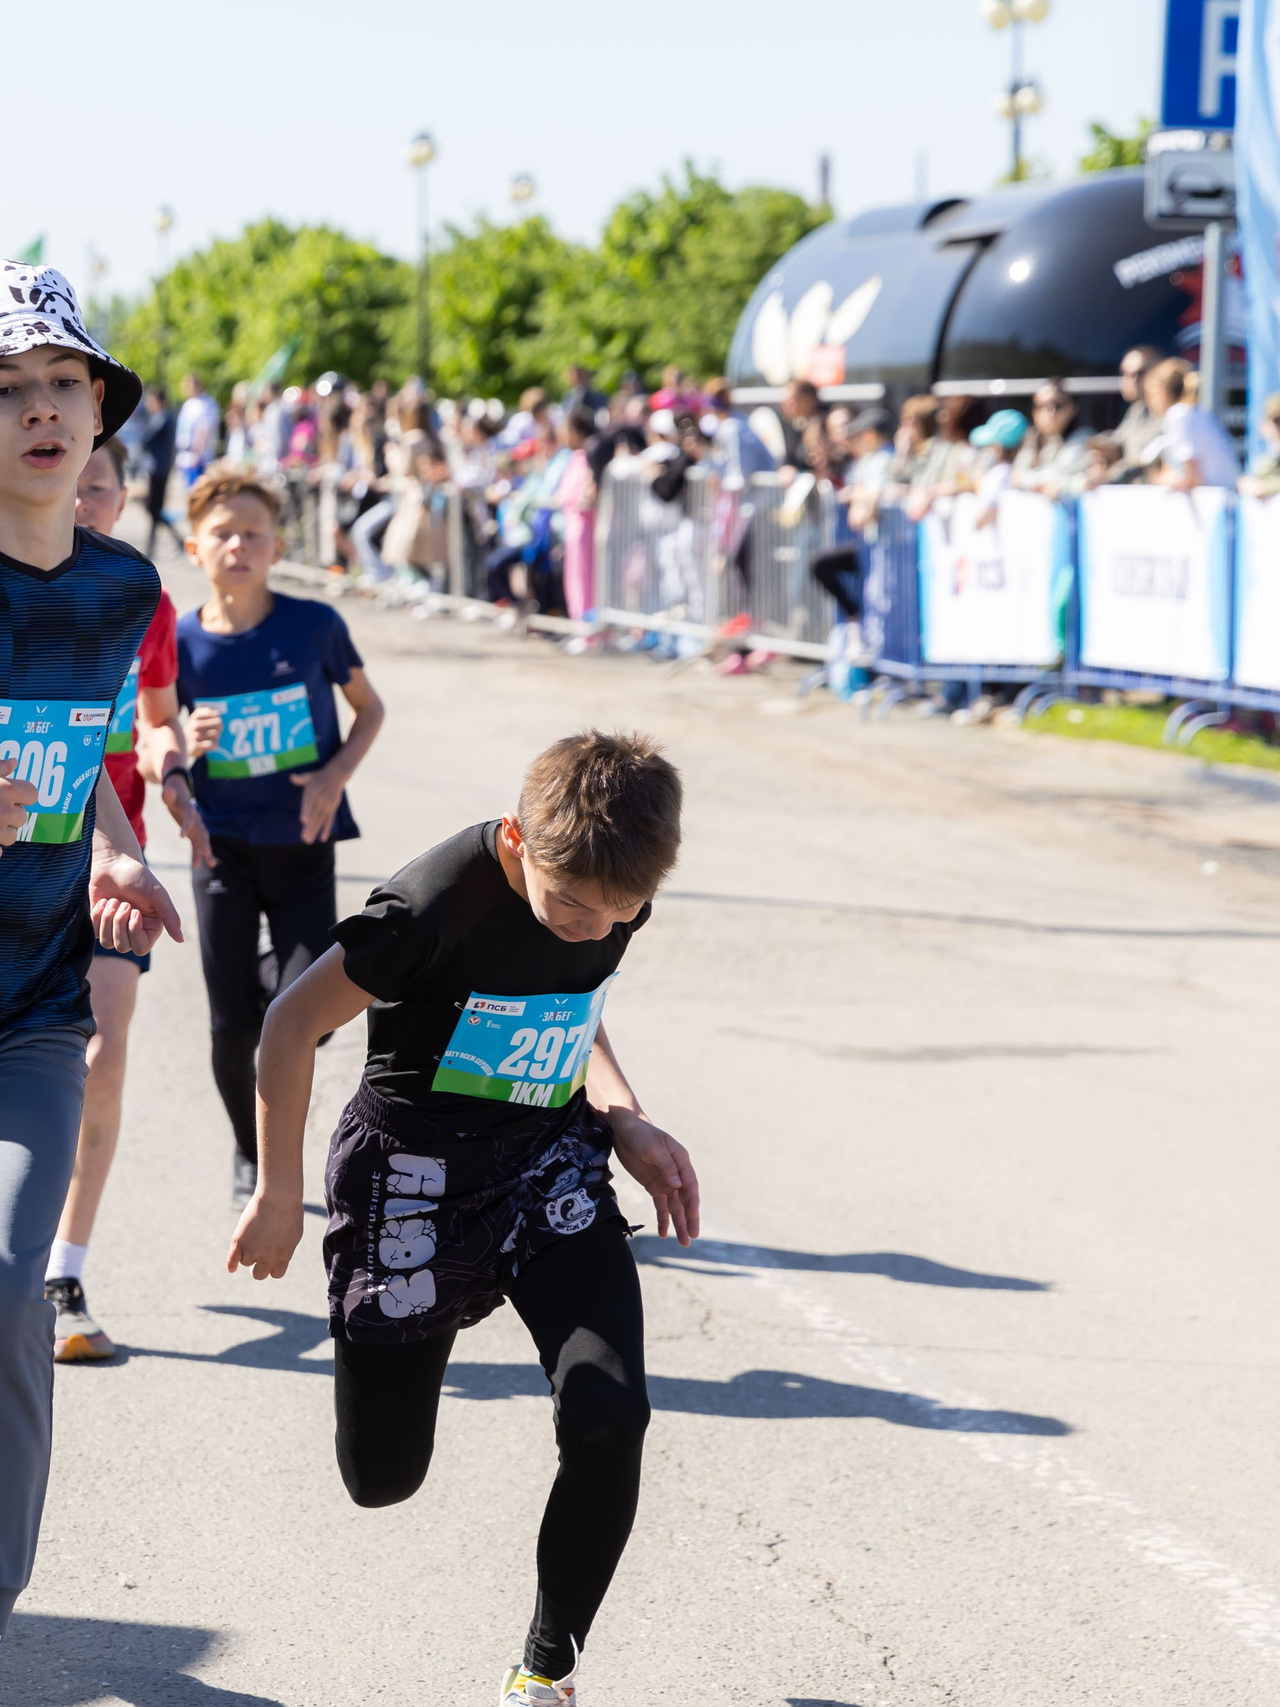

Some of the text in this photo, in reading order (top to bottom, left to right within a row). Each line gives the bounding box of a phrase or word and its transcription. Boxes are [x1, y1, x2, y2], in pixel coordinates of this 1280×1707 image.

[228, 712, 281, 757] 277
[486, 1003, 507, 1012] ПСБ
[496, 1023, 588, 1080] 297
